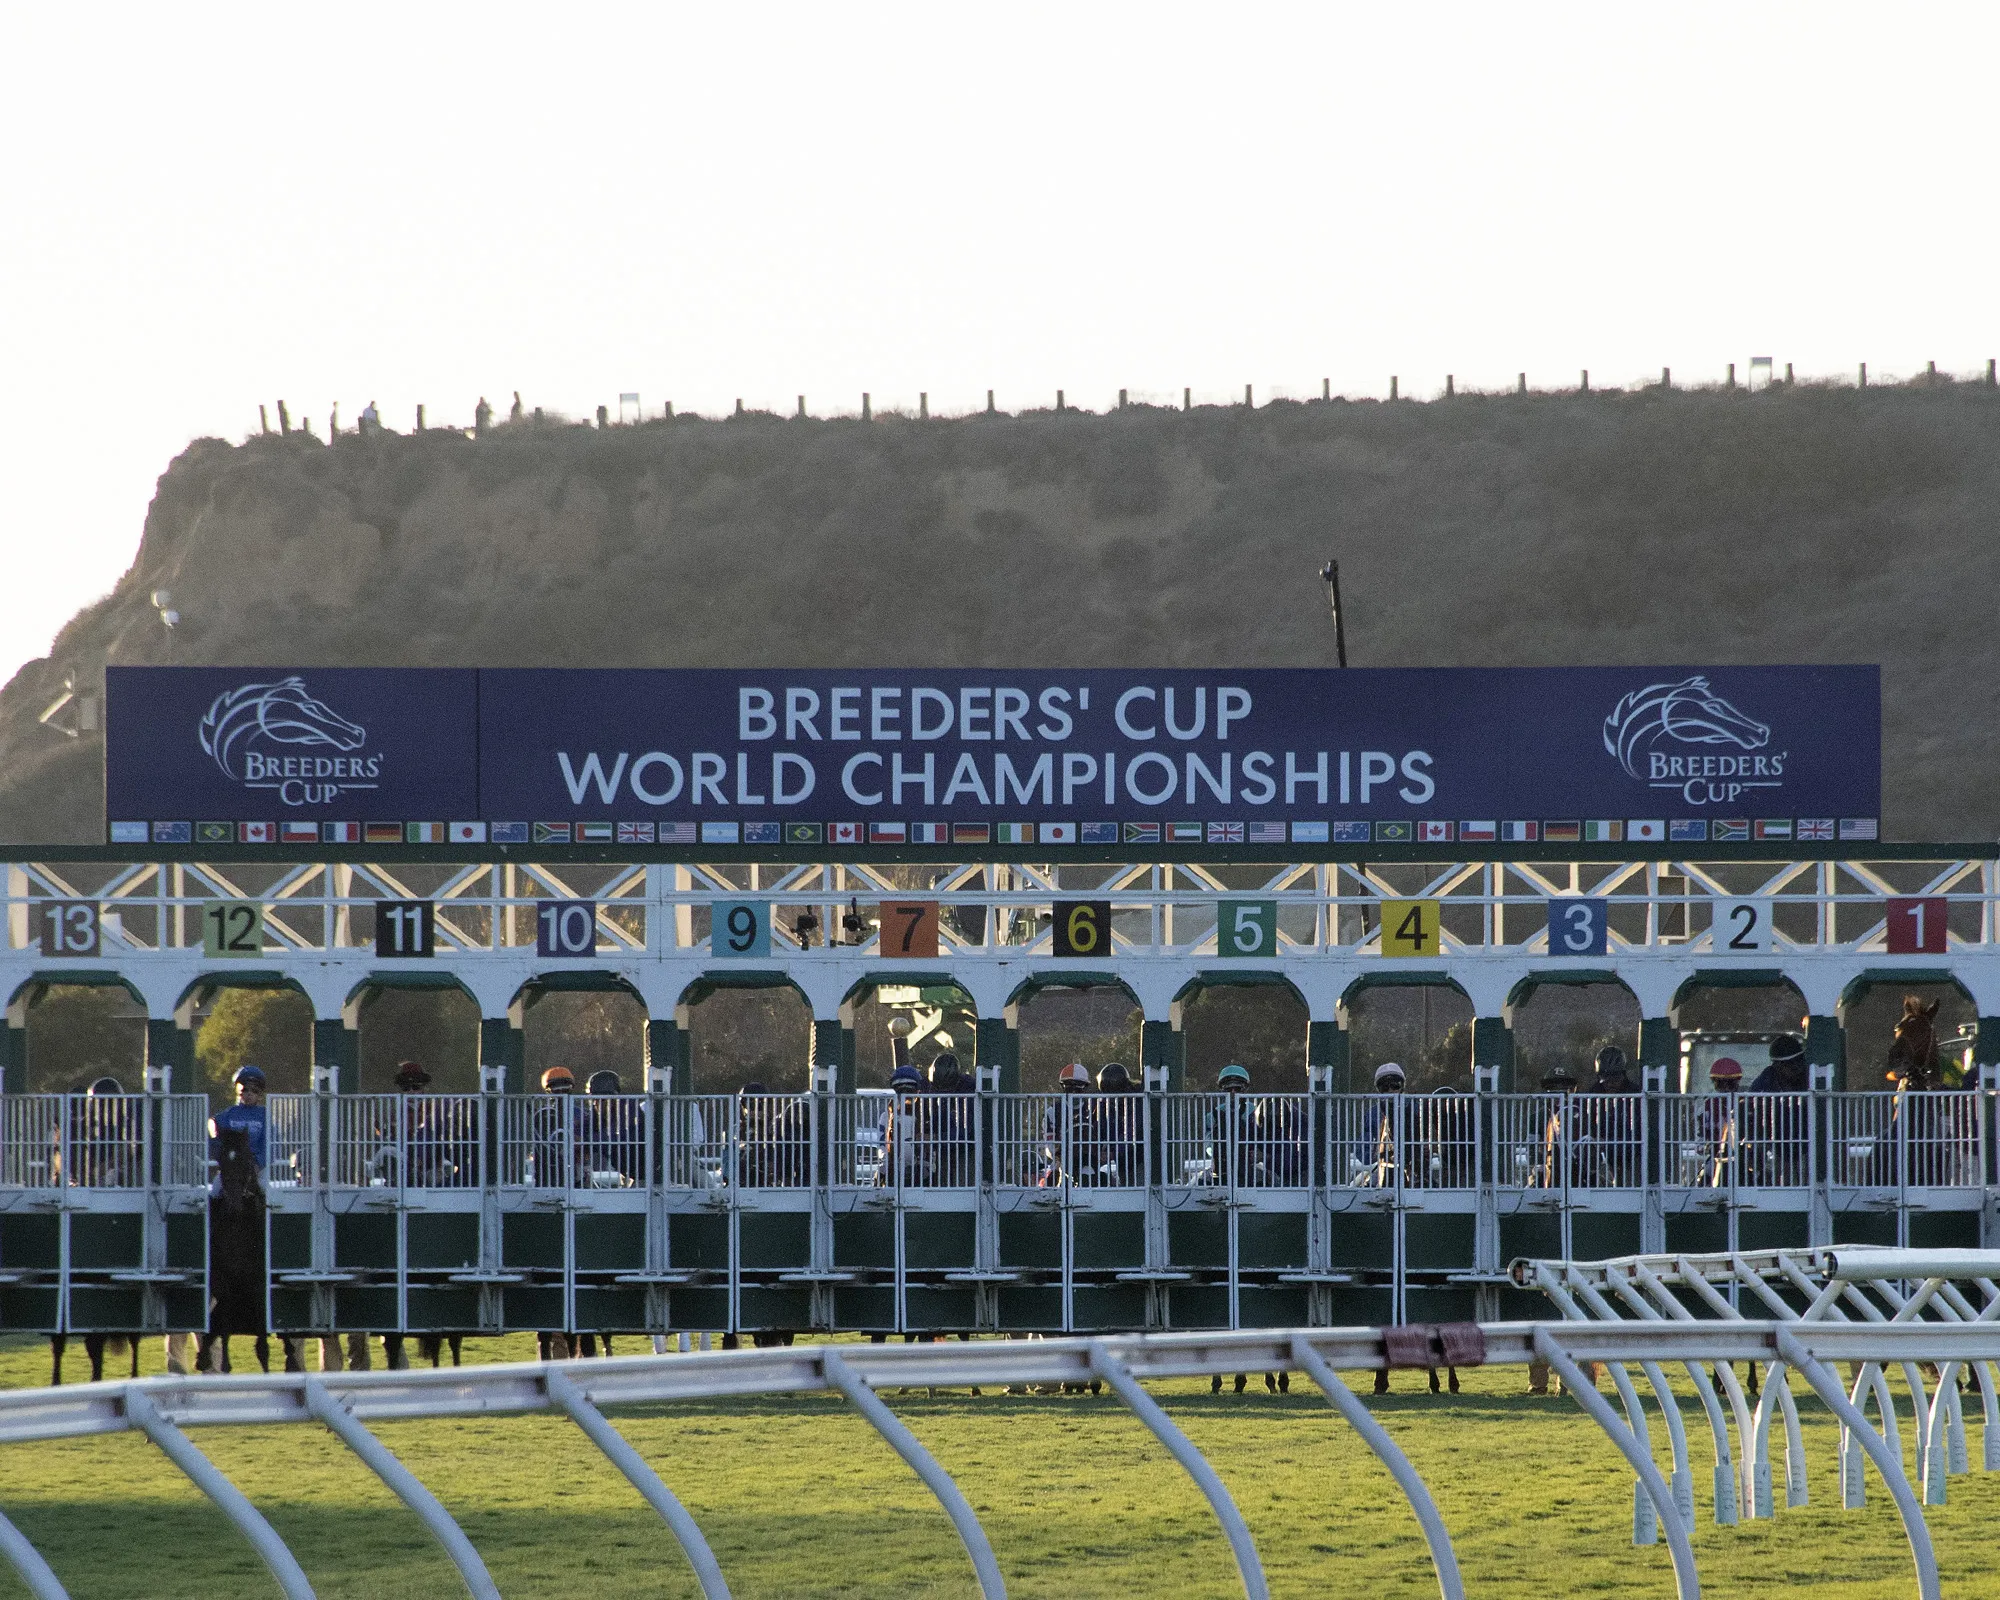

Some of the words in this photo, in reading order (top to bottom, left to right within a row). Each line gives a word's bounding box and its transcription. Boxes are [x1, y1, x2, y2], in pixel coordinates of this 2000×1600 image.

[739, 687, 1090, 741] BREEDERS'
[1114, 687, 1252, 741] CUP
[557, 751, 816, 806] WORLD
[841, 750, 1436, 806] CHAMPIONSHIPS
[45, 905, 96, 952] 13
[209, 906, 257, 951] 12
[385, 907, 423, 952] 11
[540, 906, 593, 952] 10
[727, 906, 758, 951] 9
[896, 907, 926, 952] 7
[1067, 905, 1097, 952] 6
[1233, 906, 1263, 952] 5
[1395, 905, 1428, 951] 4
[1563, 904, 1593, 951] 3
[1728, 904, 1759, 950] 2
[1906, 903, 1925, 949] 1
